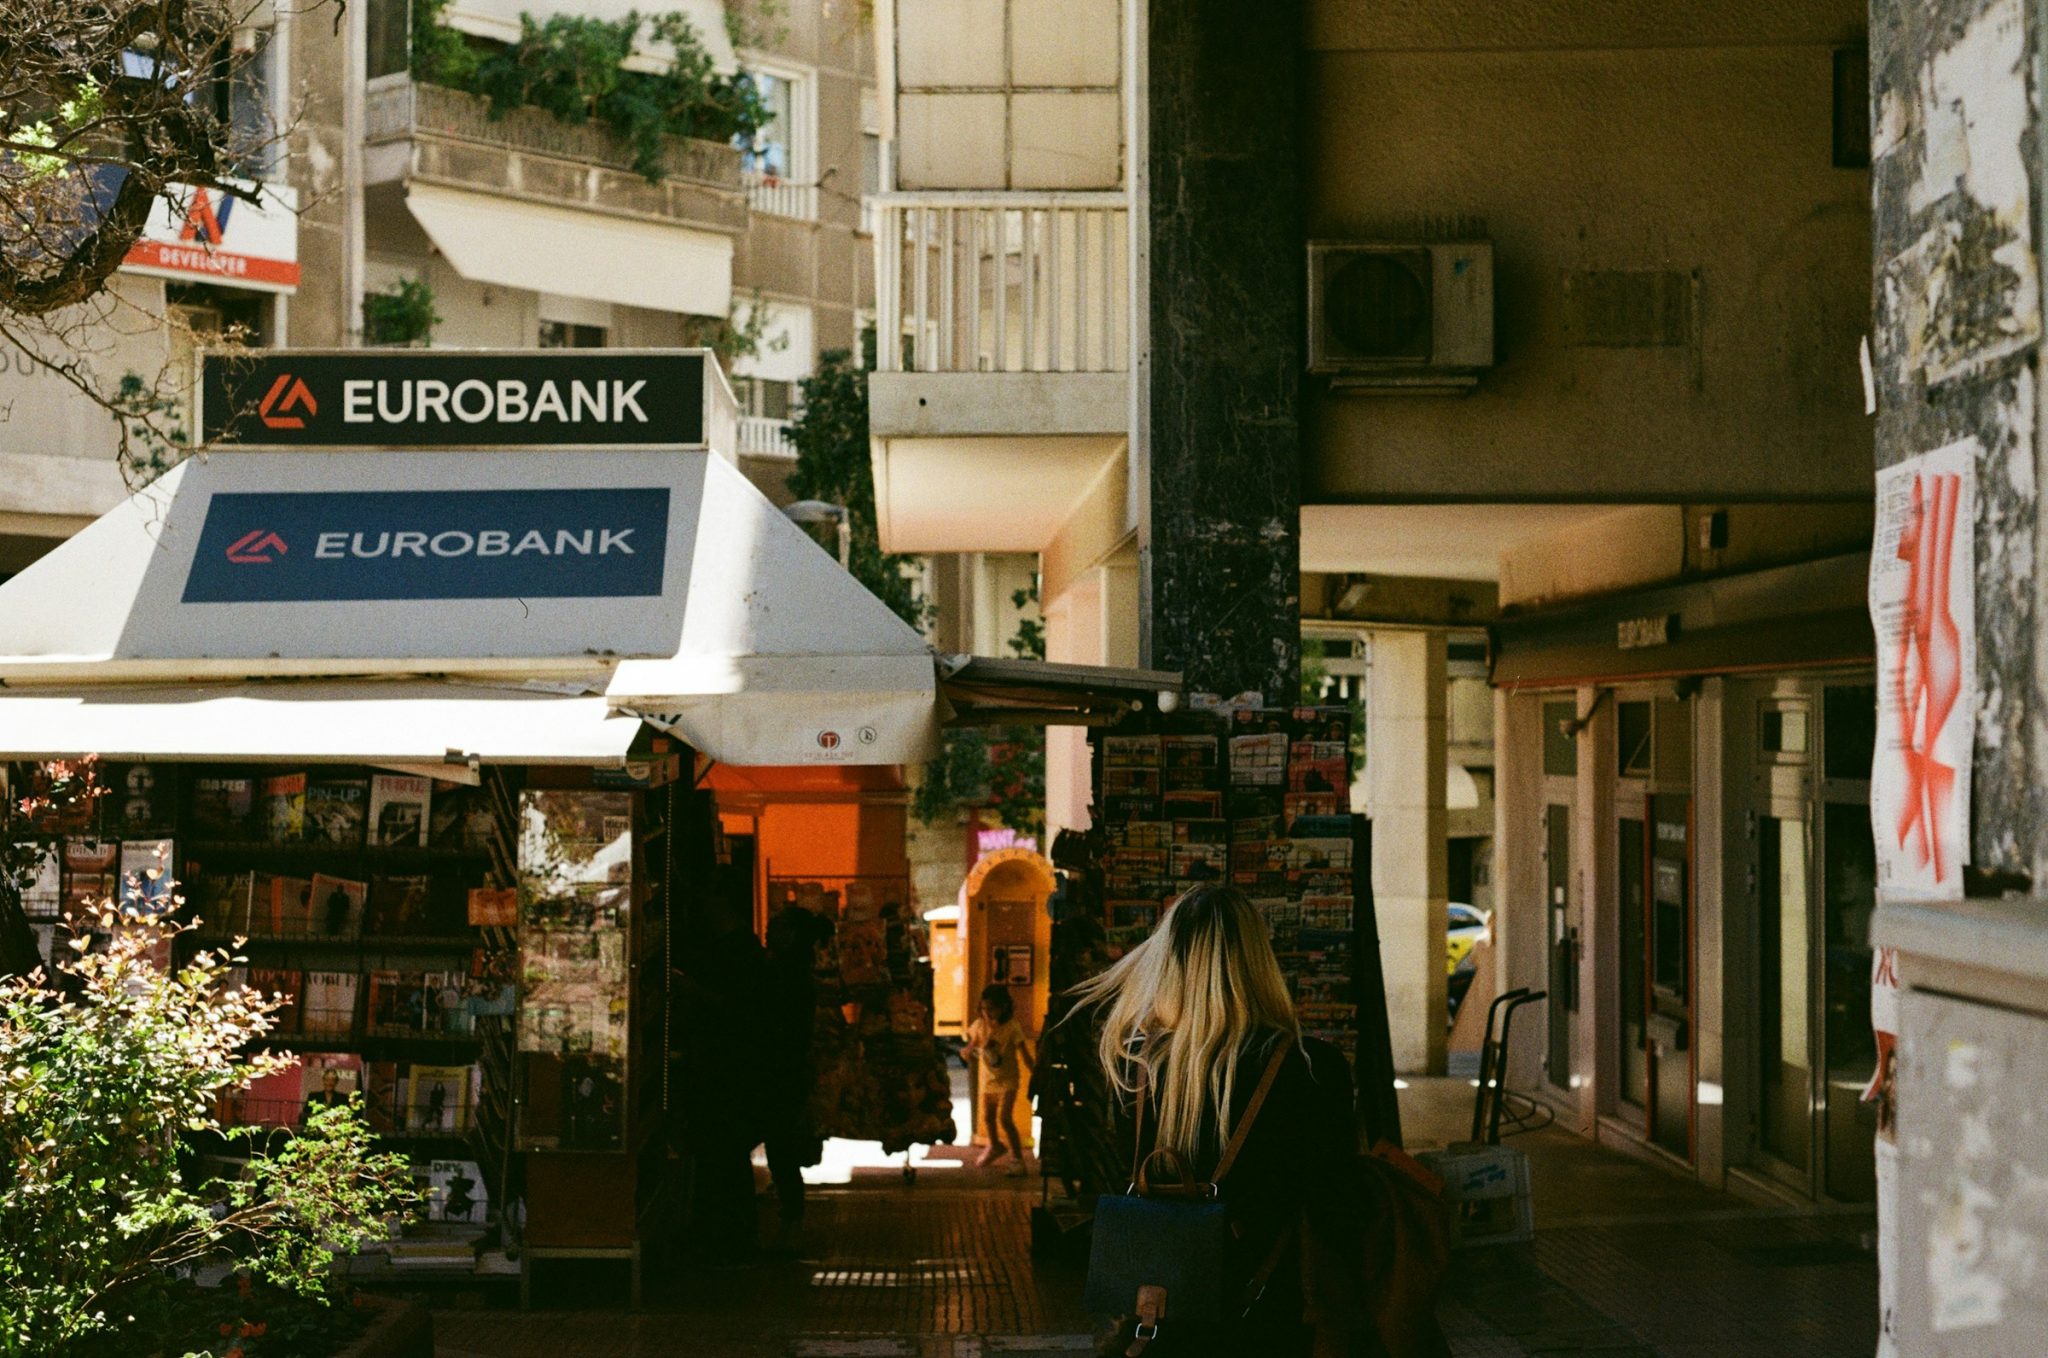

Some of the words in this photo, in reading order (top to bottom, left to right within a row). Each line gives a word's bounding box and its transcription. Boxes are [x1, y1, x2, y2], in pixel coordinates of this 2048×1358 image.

[158, 247, 248, 274] DEVELOPER
[343, 379, 649, 424] EUROBANK
[314, 528, 636, 560] EUROBANK
[307, 786, 361, 802] PIN-UP
